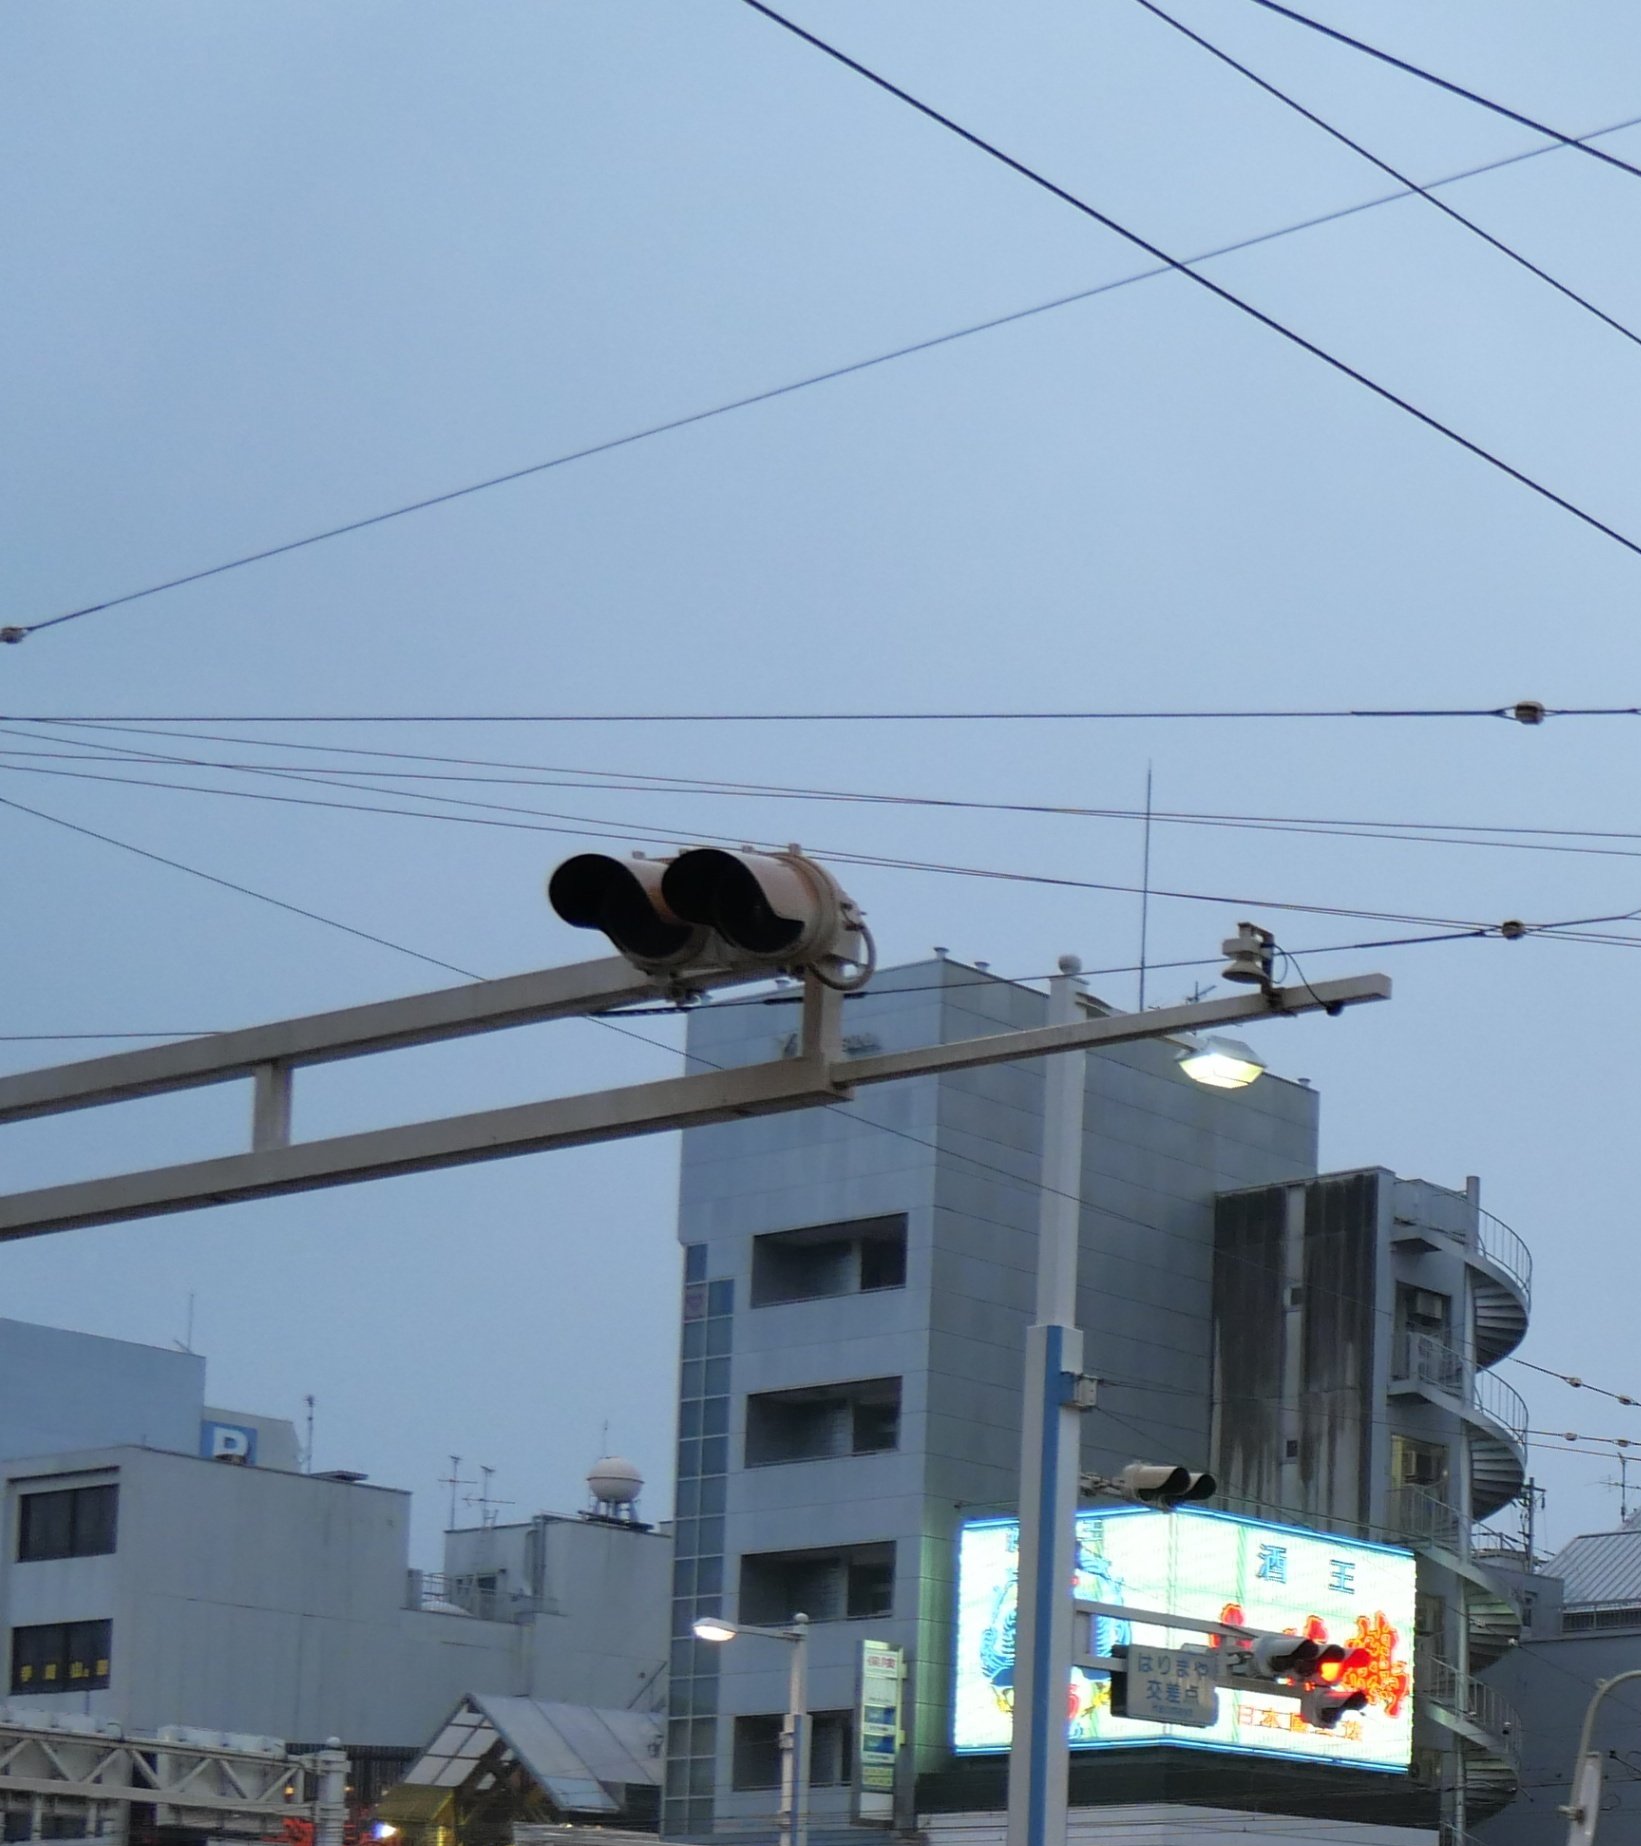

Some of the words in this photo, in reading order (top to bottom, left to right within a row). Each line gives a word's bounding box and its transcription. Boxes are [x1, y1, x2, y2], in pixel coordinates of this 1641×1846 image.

[1256, 1543, 1356, 1595] 酒王
[1138, 1653, 1210, 1678] はりまや
[1146, 1680, 1200, 1705] 交差点
